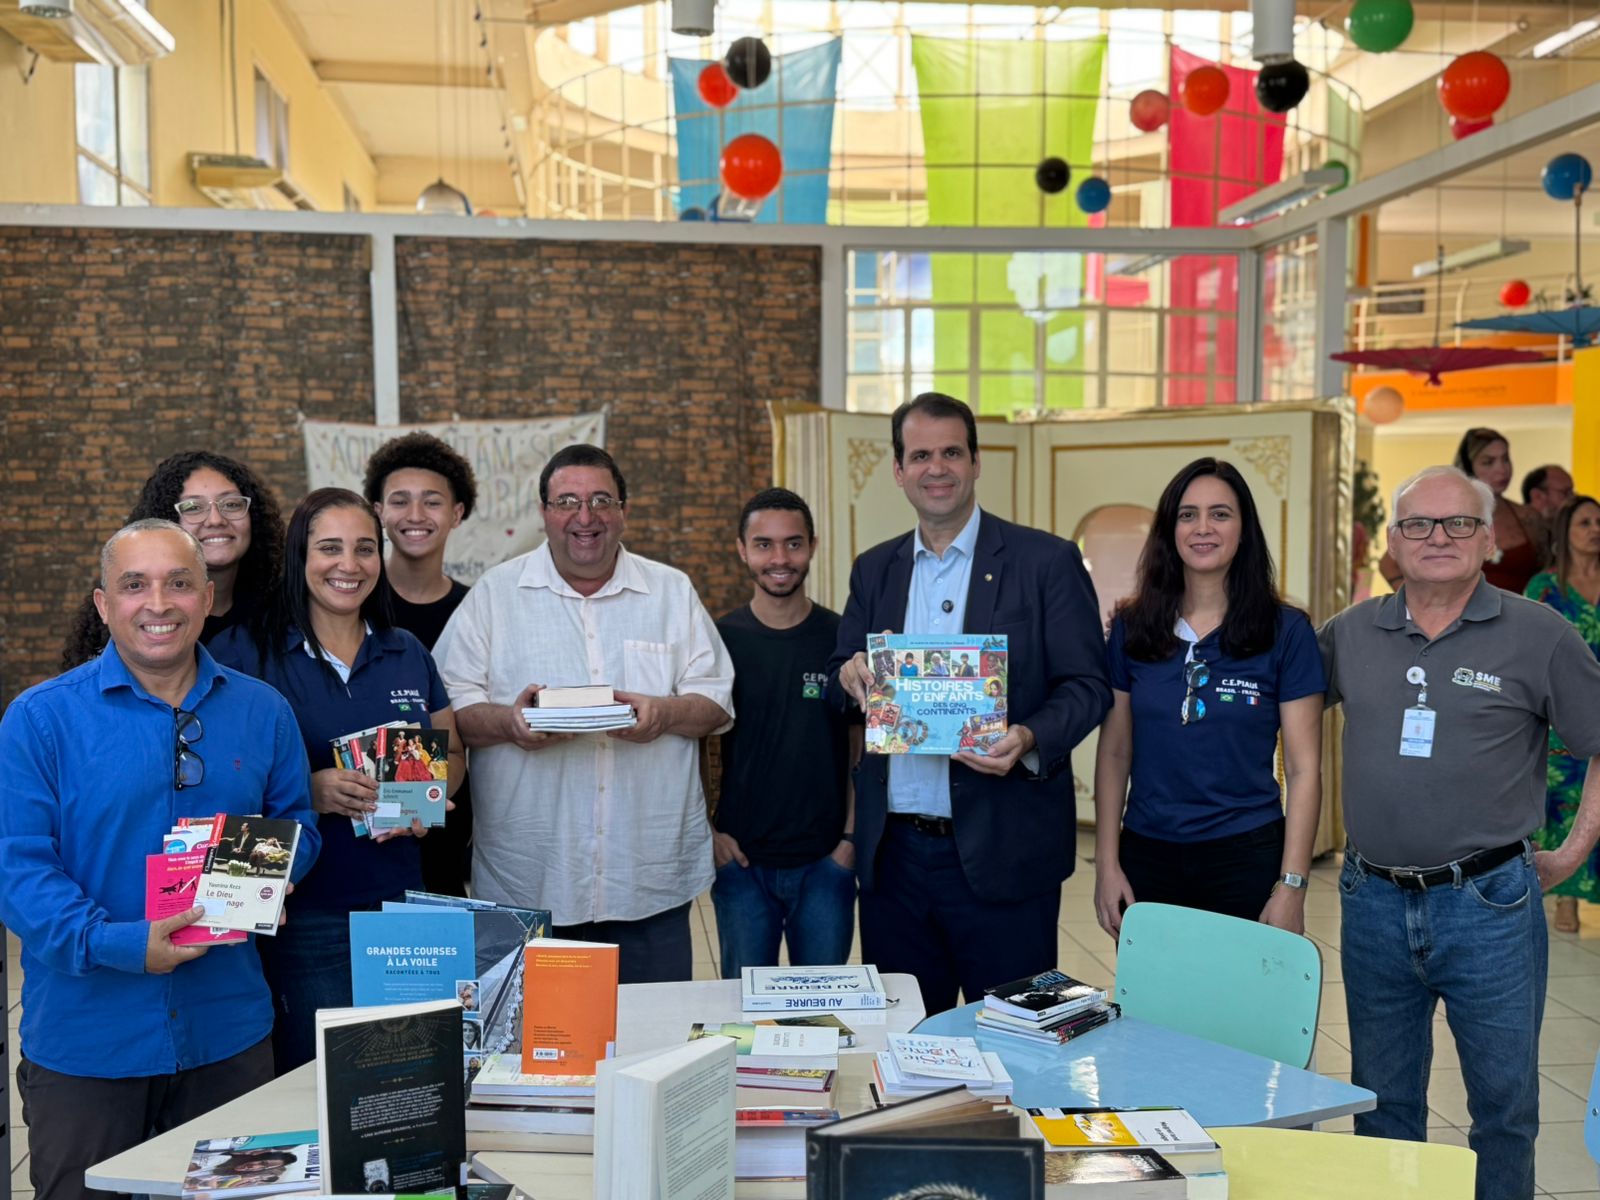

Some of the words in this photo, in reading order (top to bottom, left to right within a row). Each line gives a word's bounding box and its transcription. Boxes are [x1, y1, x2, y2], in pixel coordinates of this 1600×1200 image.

[1476, 671, 1501, 686] SME
[895, 678, 974, 692] HISTOIRES
[911, 691, 984, 702] D'ENFANTS
[917, 707, 977, 716] CONTINENTS
[206, 889, 215, 897] Le
[216, 890, 233, 898] Dieu
[226, 900, 244, 908] nage
[366, 946, 411, 956] GRANDES
[413, 946, 457, 956] COURSES
[386, 955, 394, 966] À
[396, 958, 408, 966] LA
[410, 958, 438, 966] VOILE
[785, 998, 826, 1008] BEURRE
[829, 998, 843, 1006] AU
